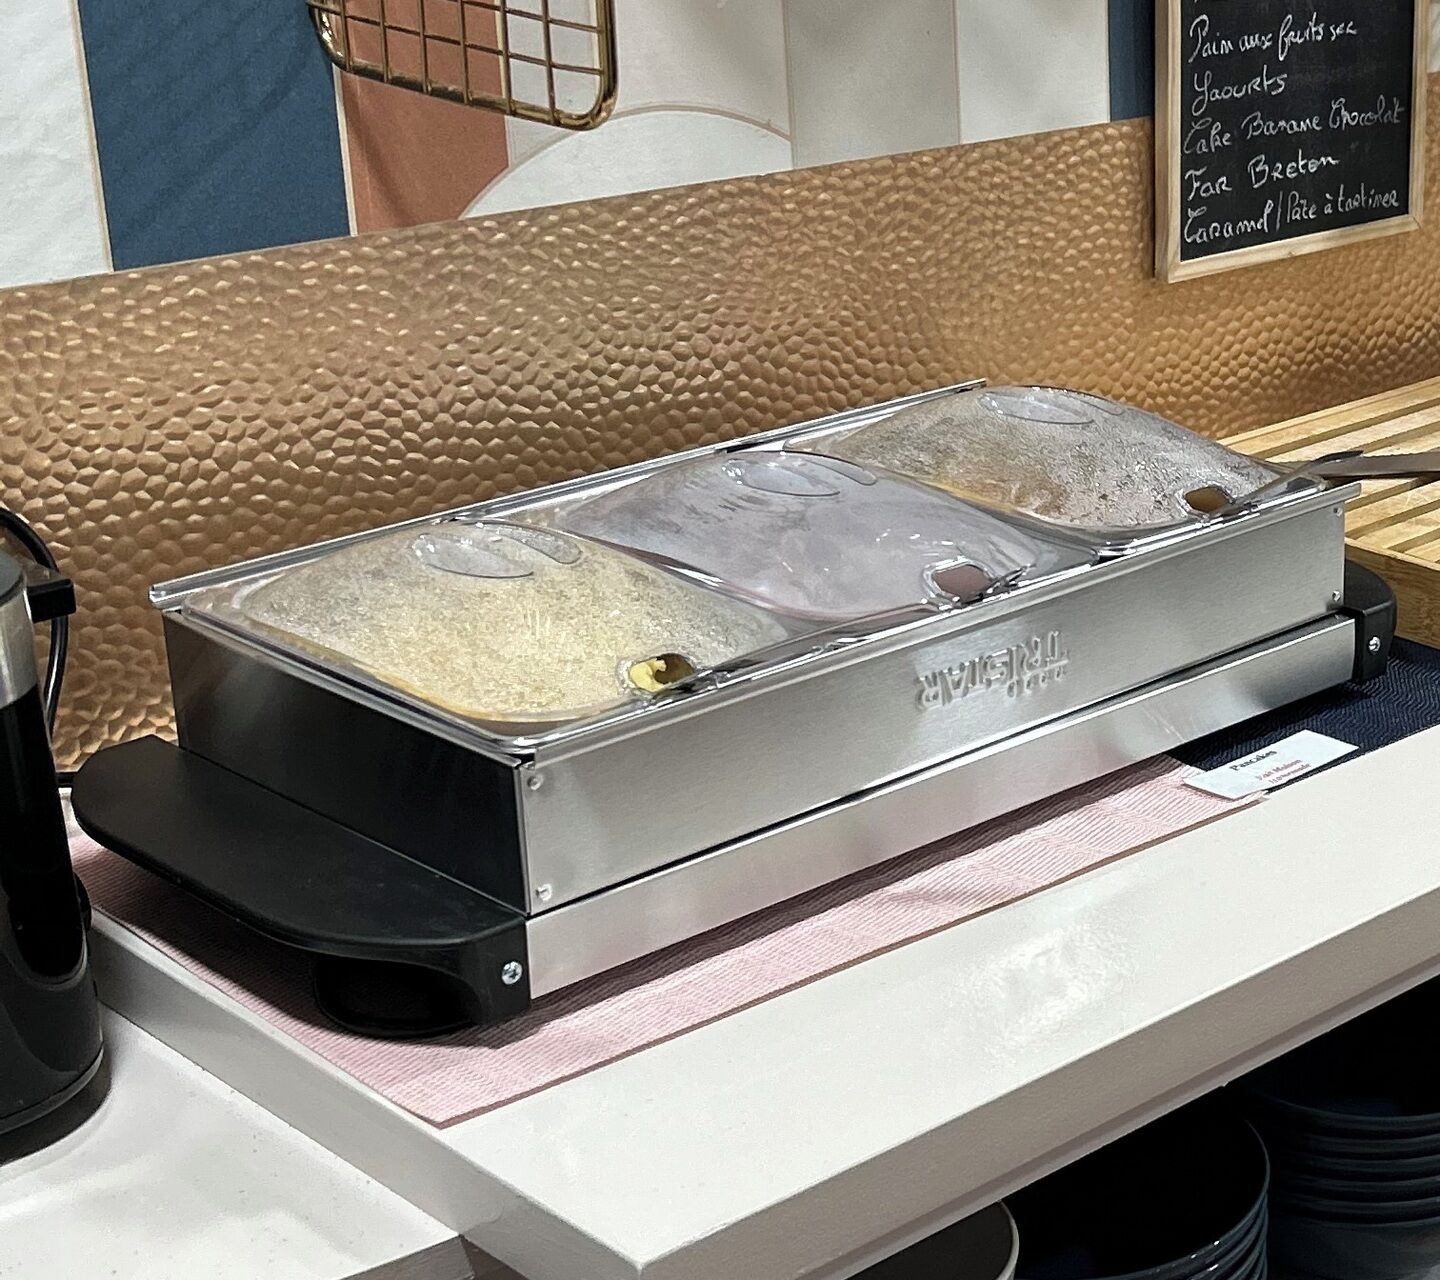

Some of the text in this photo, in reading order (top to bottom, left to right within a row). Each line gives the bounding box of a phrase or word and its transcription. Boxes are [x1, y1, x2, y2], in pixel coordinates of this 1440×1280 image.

[1188, 13, 1234, 63] Pain
[1238, 32, 1273, 52] aux
[1182, 117, 1232, 155] Cake
[914, 630, 1071, 711] TRISTAR
[1229, 750, 1278, 771] Pancakes
